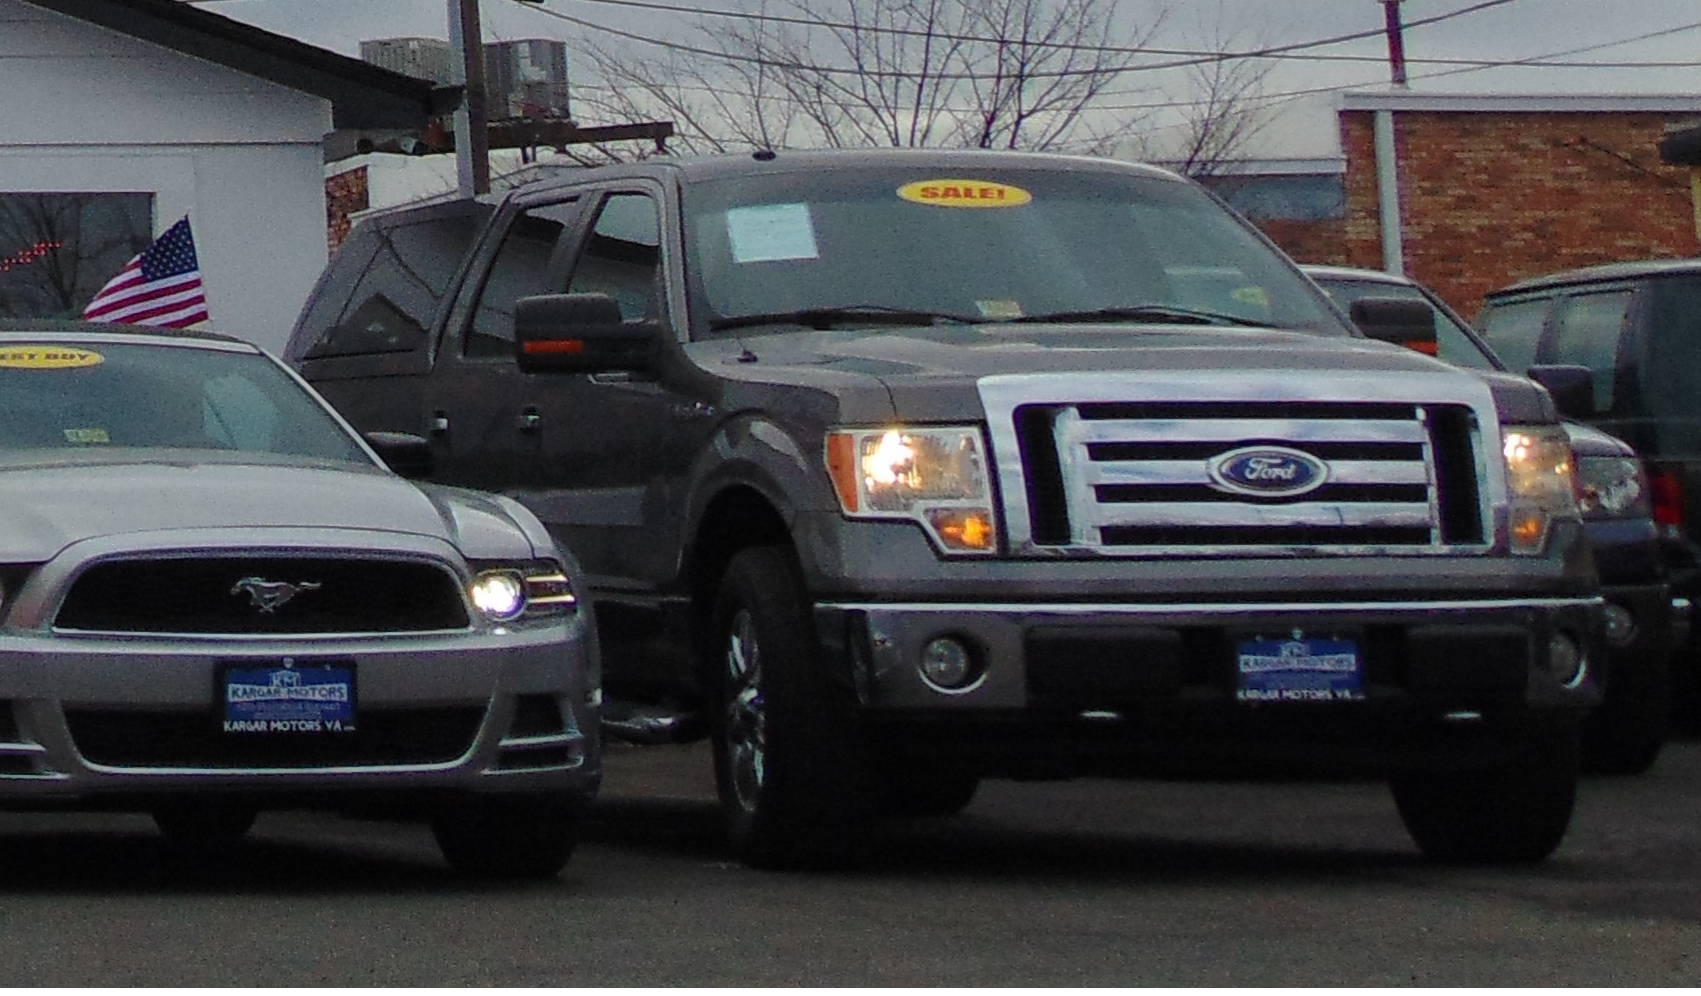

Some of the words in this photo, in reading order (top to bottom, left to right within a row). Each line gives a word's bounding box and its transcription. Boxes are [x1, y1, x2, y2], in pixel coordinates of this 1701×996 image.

[920, 187, 1006, 200] SALE!
[1244, 457, 1297, 480] Ford
[223, 720, 268, 731] KARGAR
[270, 720, 321, 731] MOTORS
